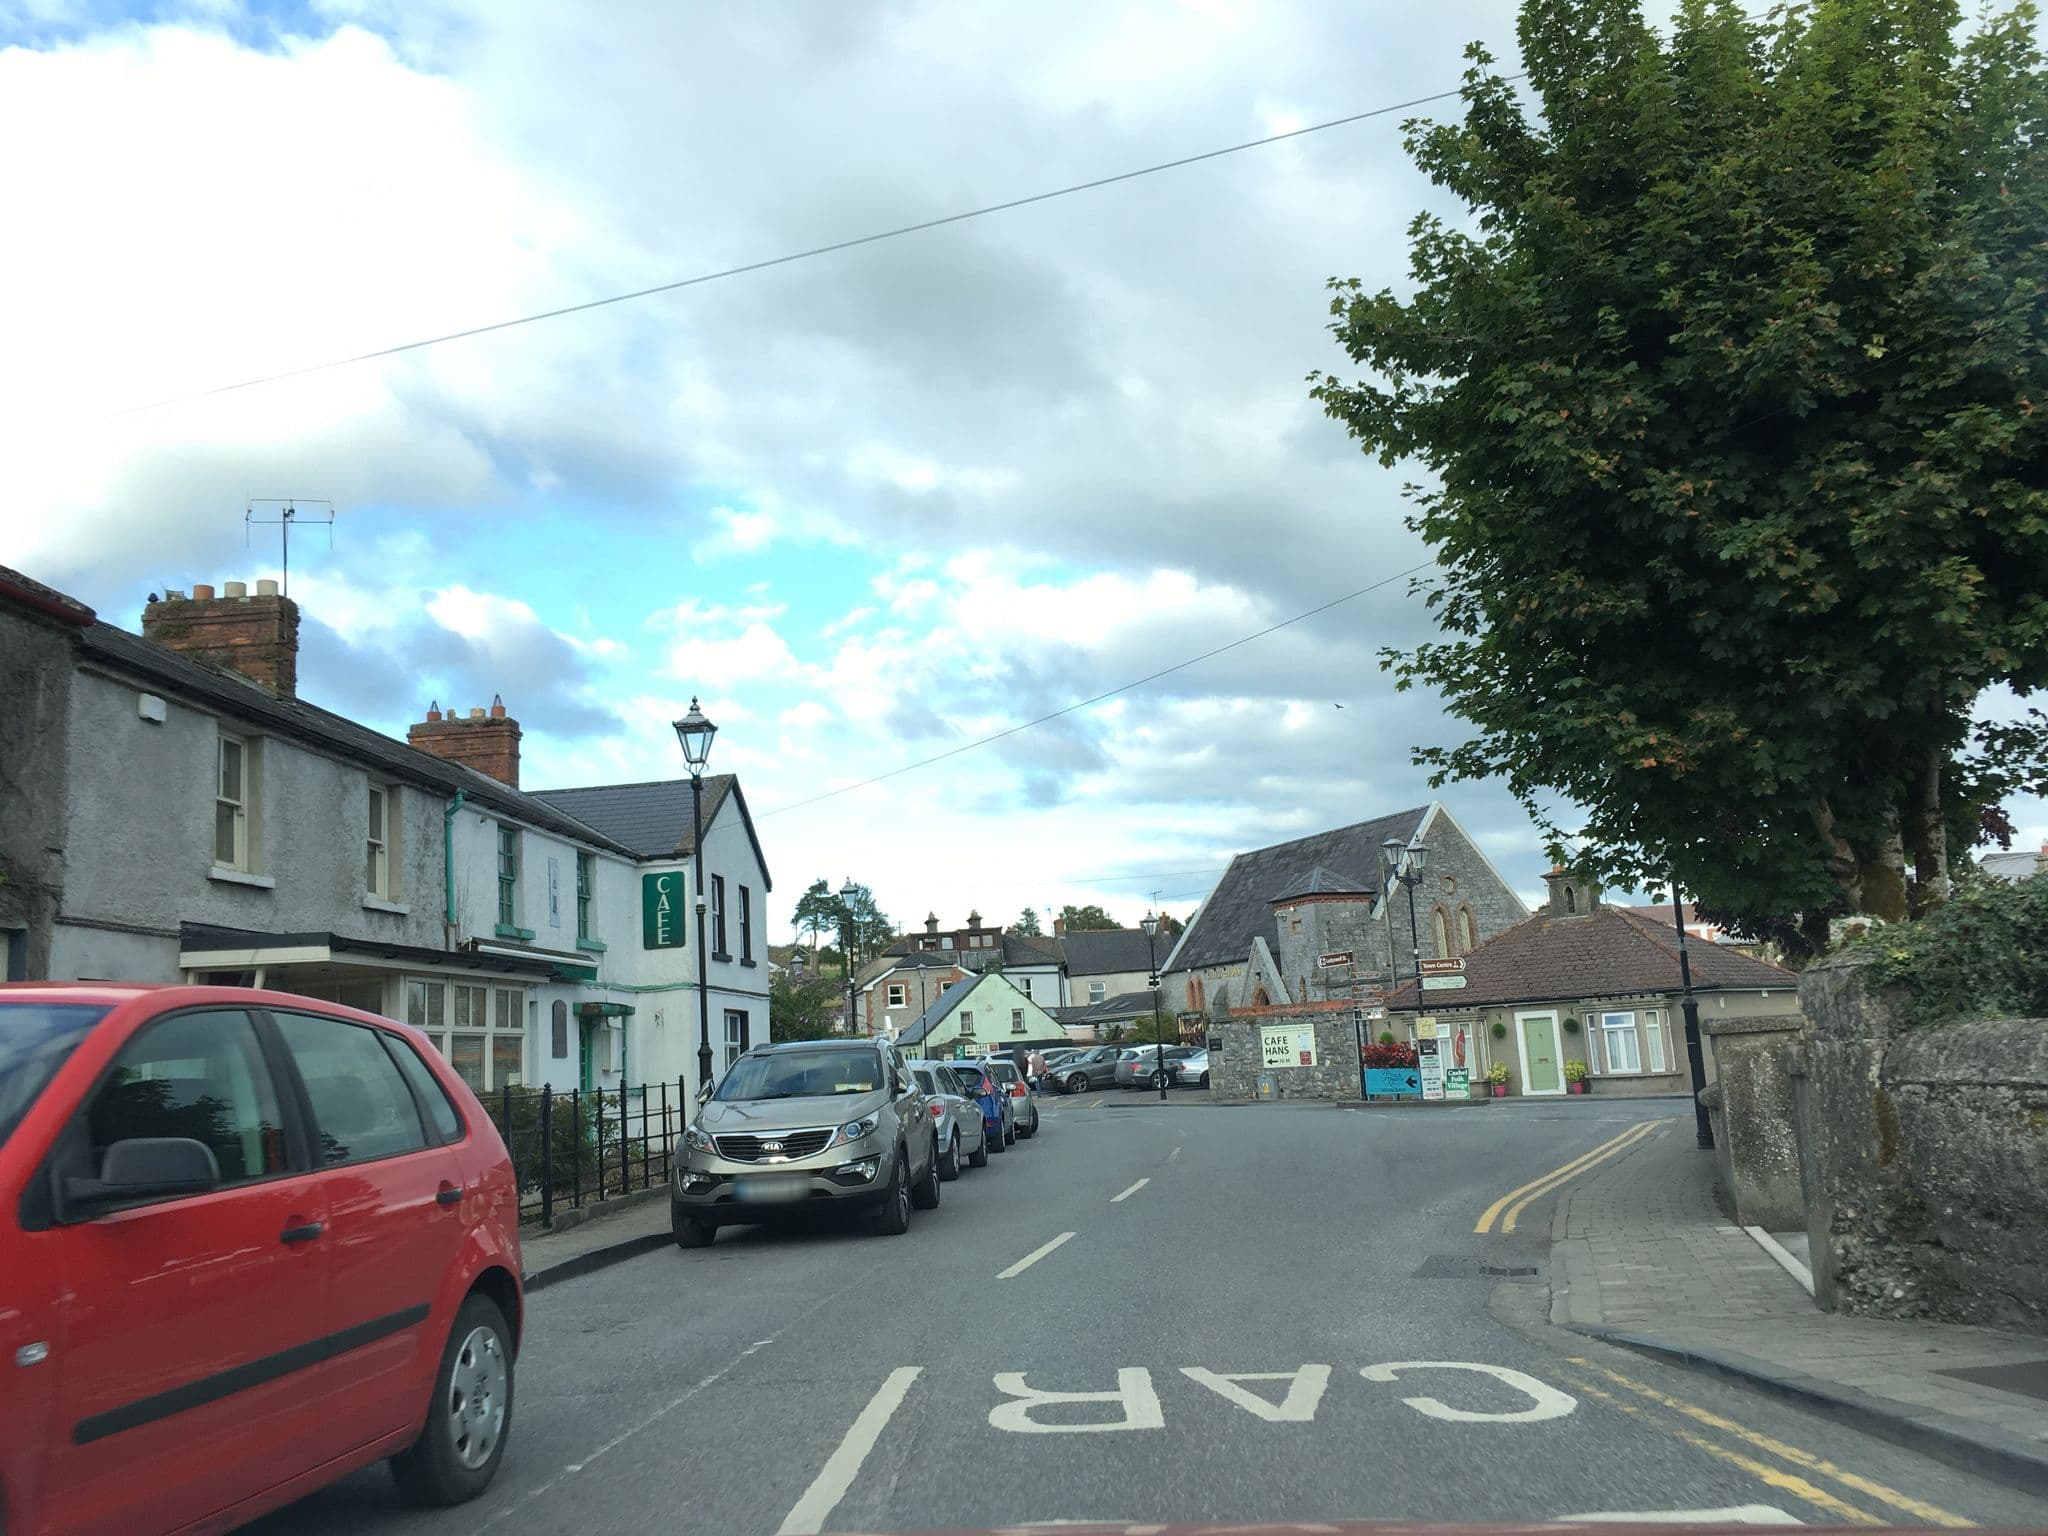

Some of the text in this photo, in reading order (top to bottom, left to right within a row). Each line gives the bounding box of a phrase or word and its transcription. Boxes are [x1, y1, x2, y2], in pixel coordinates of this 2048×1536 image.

[657, 876, 671, 945] CAFE
[1264, 1036, 1288, 1046] CAFE
[1265, 1046, 1290, 1055] HANS
[1447, 1068, 1468, 1076] Cashel
[988, 1362, 1578, 1433] CAR
